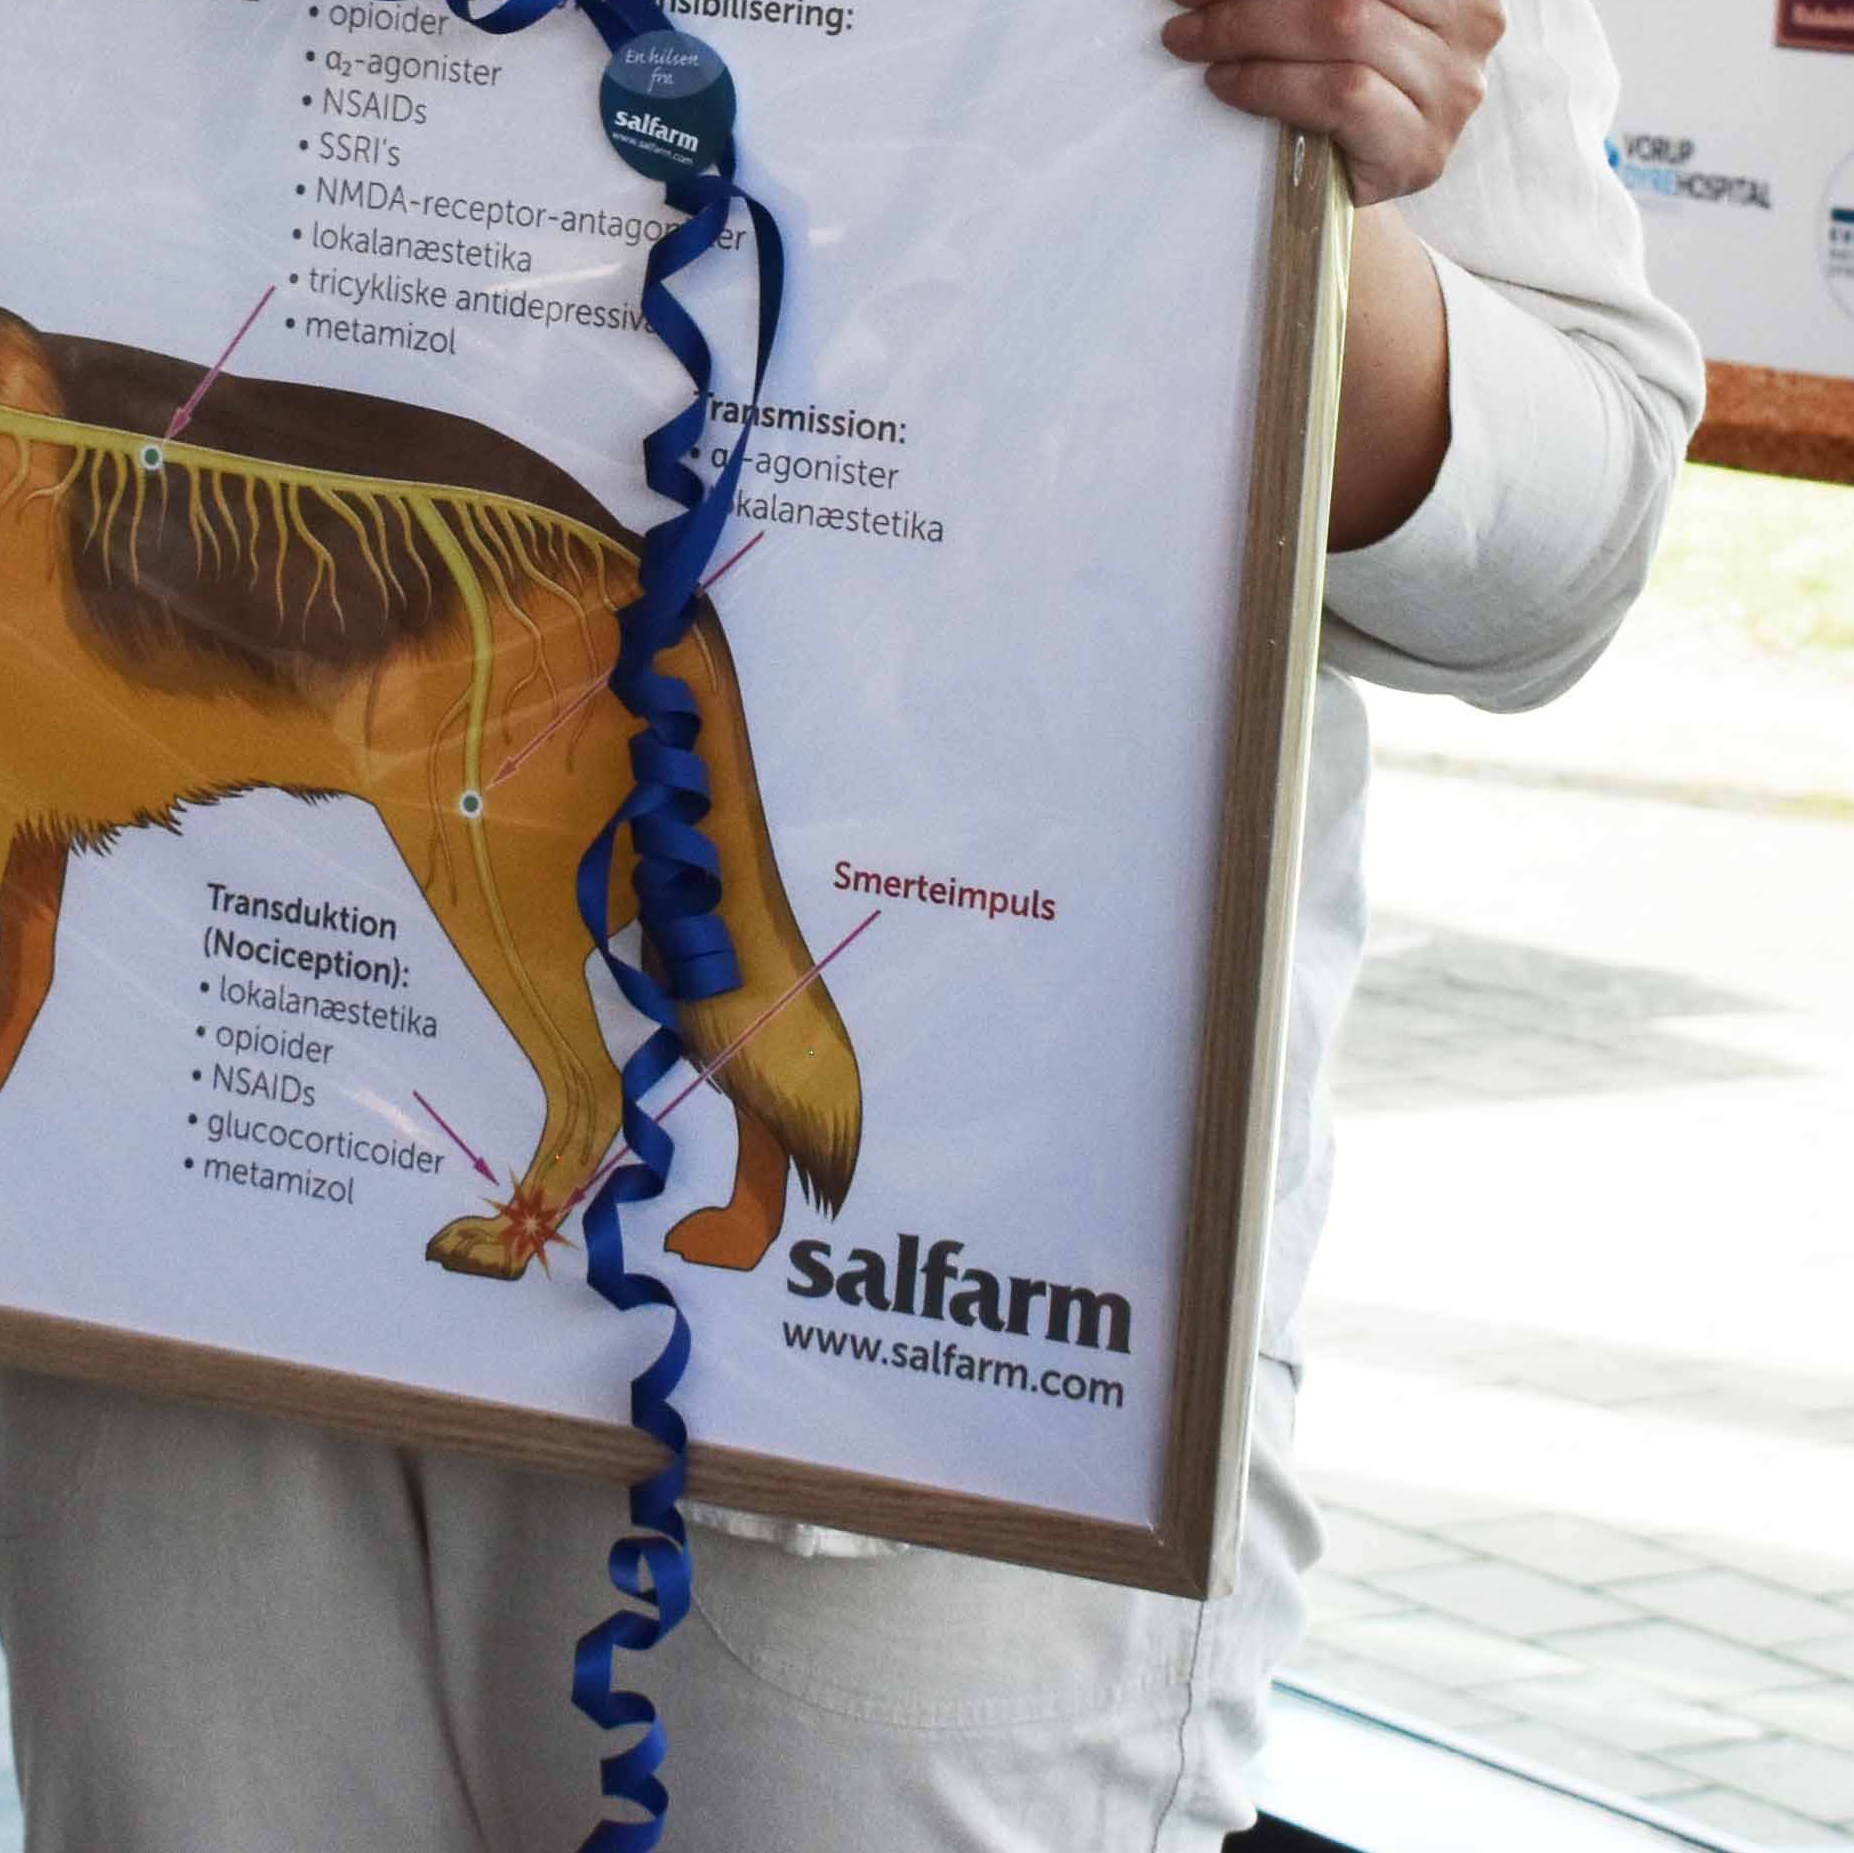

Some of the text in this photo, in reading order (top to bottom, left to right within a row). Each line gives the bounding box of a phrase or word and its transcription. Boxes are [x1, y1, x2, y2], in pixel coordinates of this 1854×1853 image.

[328, 1, 449, 36] opioider
[648, 46, 700, 67] hilsen
[648, 66, 675, 93] fra
[322, 88, 428, 125] NSAIDs
[614, 109, 699, 153] salfarm
[318, 132, 402, 168] SSRI's
[315, 177, 747, 251] NMDA-receptor-antagoer
[311, 222, 533, 272] lokalanæstetika
[309, 267, 448, 308] tricykliske
[305, 313, 457, 355] metamizol
[694, 389, 907, 445] ransmission:
[727, 489, 944, 543] kalanæstetika
[207, 882, 398, 941] Transduktion
[833, 861, 1057, 921] Smerteimpuls
[204, 926, 410, 990] (Nociception):
[219, 975, 438, 1039] lokalanæstetika
[215, 1024, 335, 1065] opioider
[212, 1063, 316, 1108] NSAIDs
[207, 1109, 446, 1175] glucocorticoider
[203, 1156, 356, 1205] metamizol
[786, 1232, 1132, 1355] salfarm
[782, 1320, 1125, 1409] www.salfarm.com
